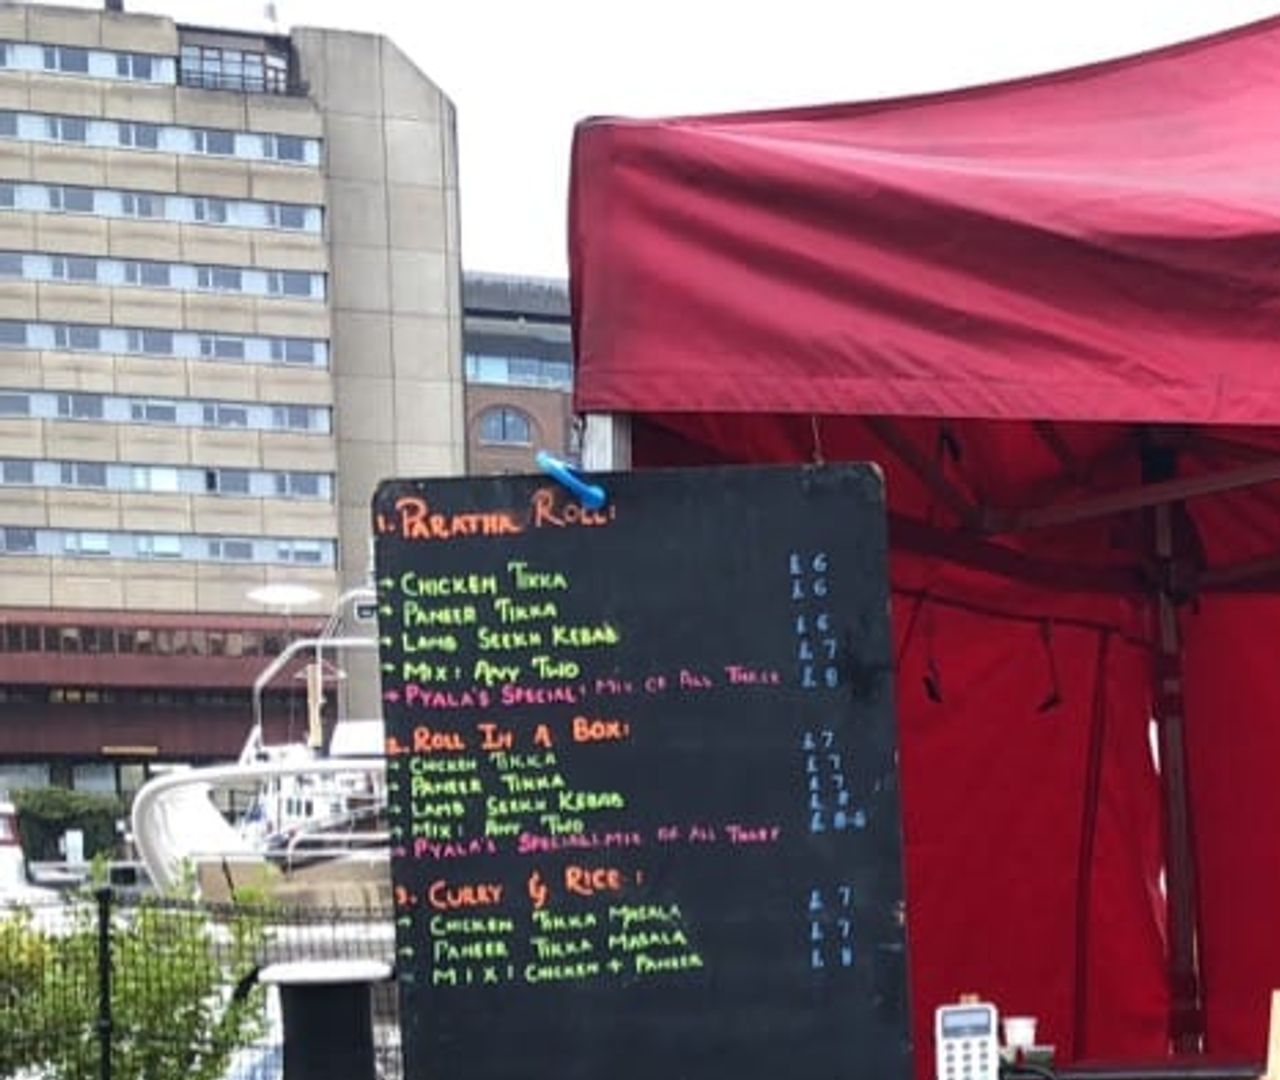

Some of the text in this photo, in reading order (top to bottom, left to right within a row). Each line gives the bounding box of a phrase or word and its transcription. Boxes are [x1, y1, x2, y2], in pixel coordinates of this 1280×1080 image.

[396, 497, 524, 538] PARATHA
[401, 572, 497, 596] CHICKEN
[508, 562, 567, 590] TIKKA
[403, 602, 476, 626] PANEER
[495, 598, 556, 622] TIKKA
[403, 633, 457, 651] LAMB
[553, 625, 618, 646] KEBAB
[474, 660, 519, 686] ANY
[532, 656, 580, 679] TWO
[414, 727, 464, 750] ROLL
[478, 723, 513, 750] IN
[535, 725, 552, 748] A
[410, 757, 477, 775] CHICKEN
[429, 880, 503, 909] CURRY
[430, 916, 514, 935] CHICKEN
[532, 910, 597, 929] TIKKA
[434, 940, 508, 962] PANEER
[530, 937, 593, 957] TIKKA
